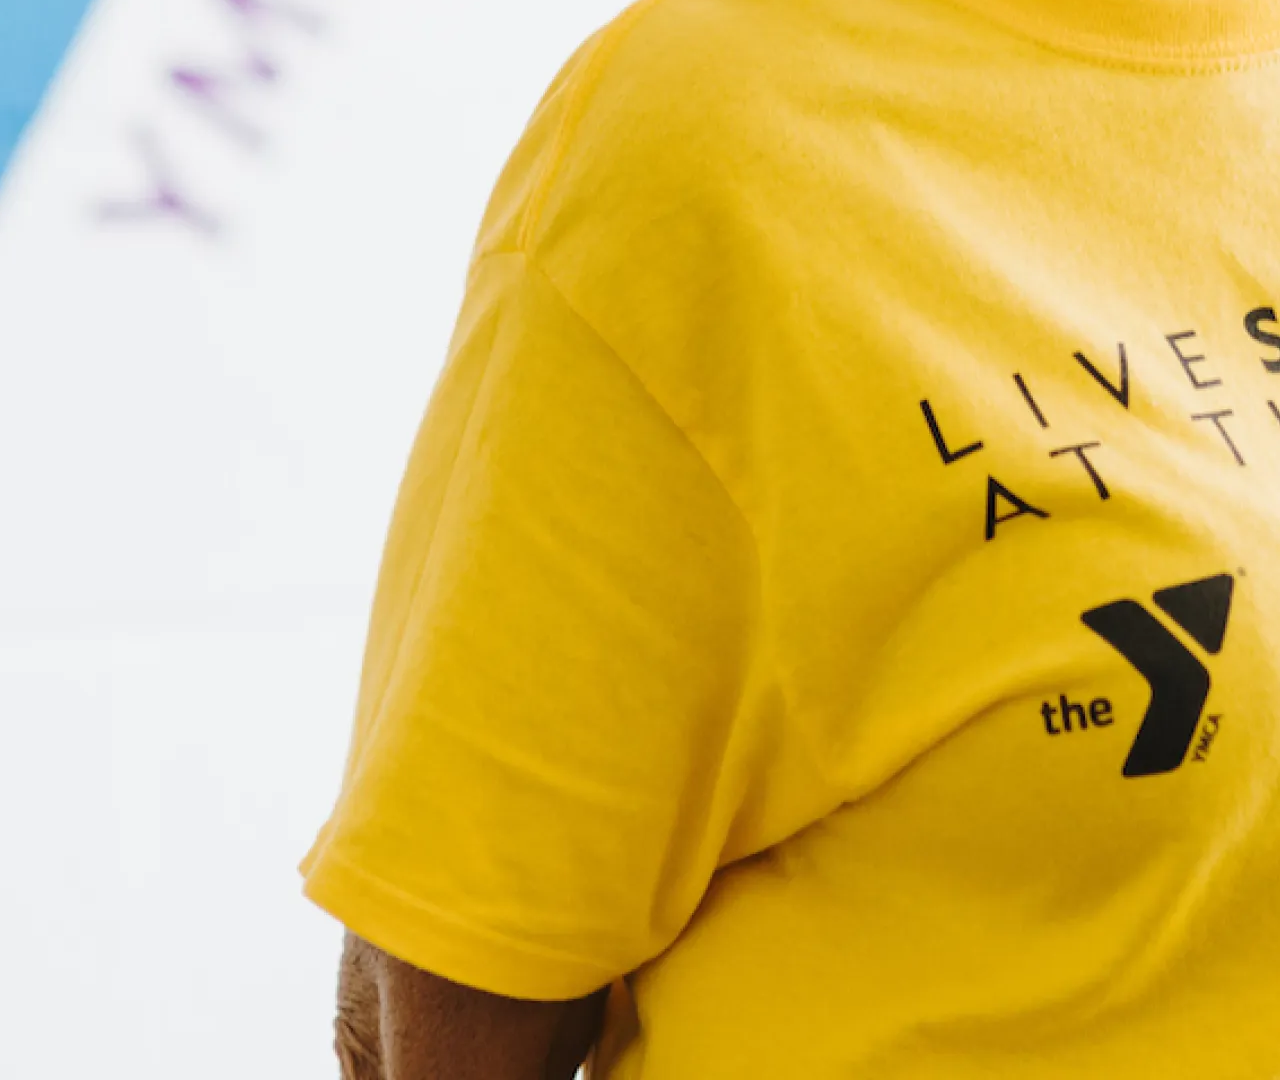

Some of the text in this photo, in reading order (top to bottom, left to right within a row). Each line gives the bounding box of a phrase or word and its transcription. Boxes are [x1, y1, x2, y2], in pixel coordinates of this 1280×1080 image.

[984, 440, 1111, 541] AT
[1040, 693, 1115, 736] the
[1190, 713, 1223, 763] YMCA
